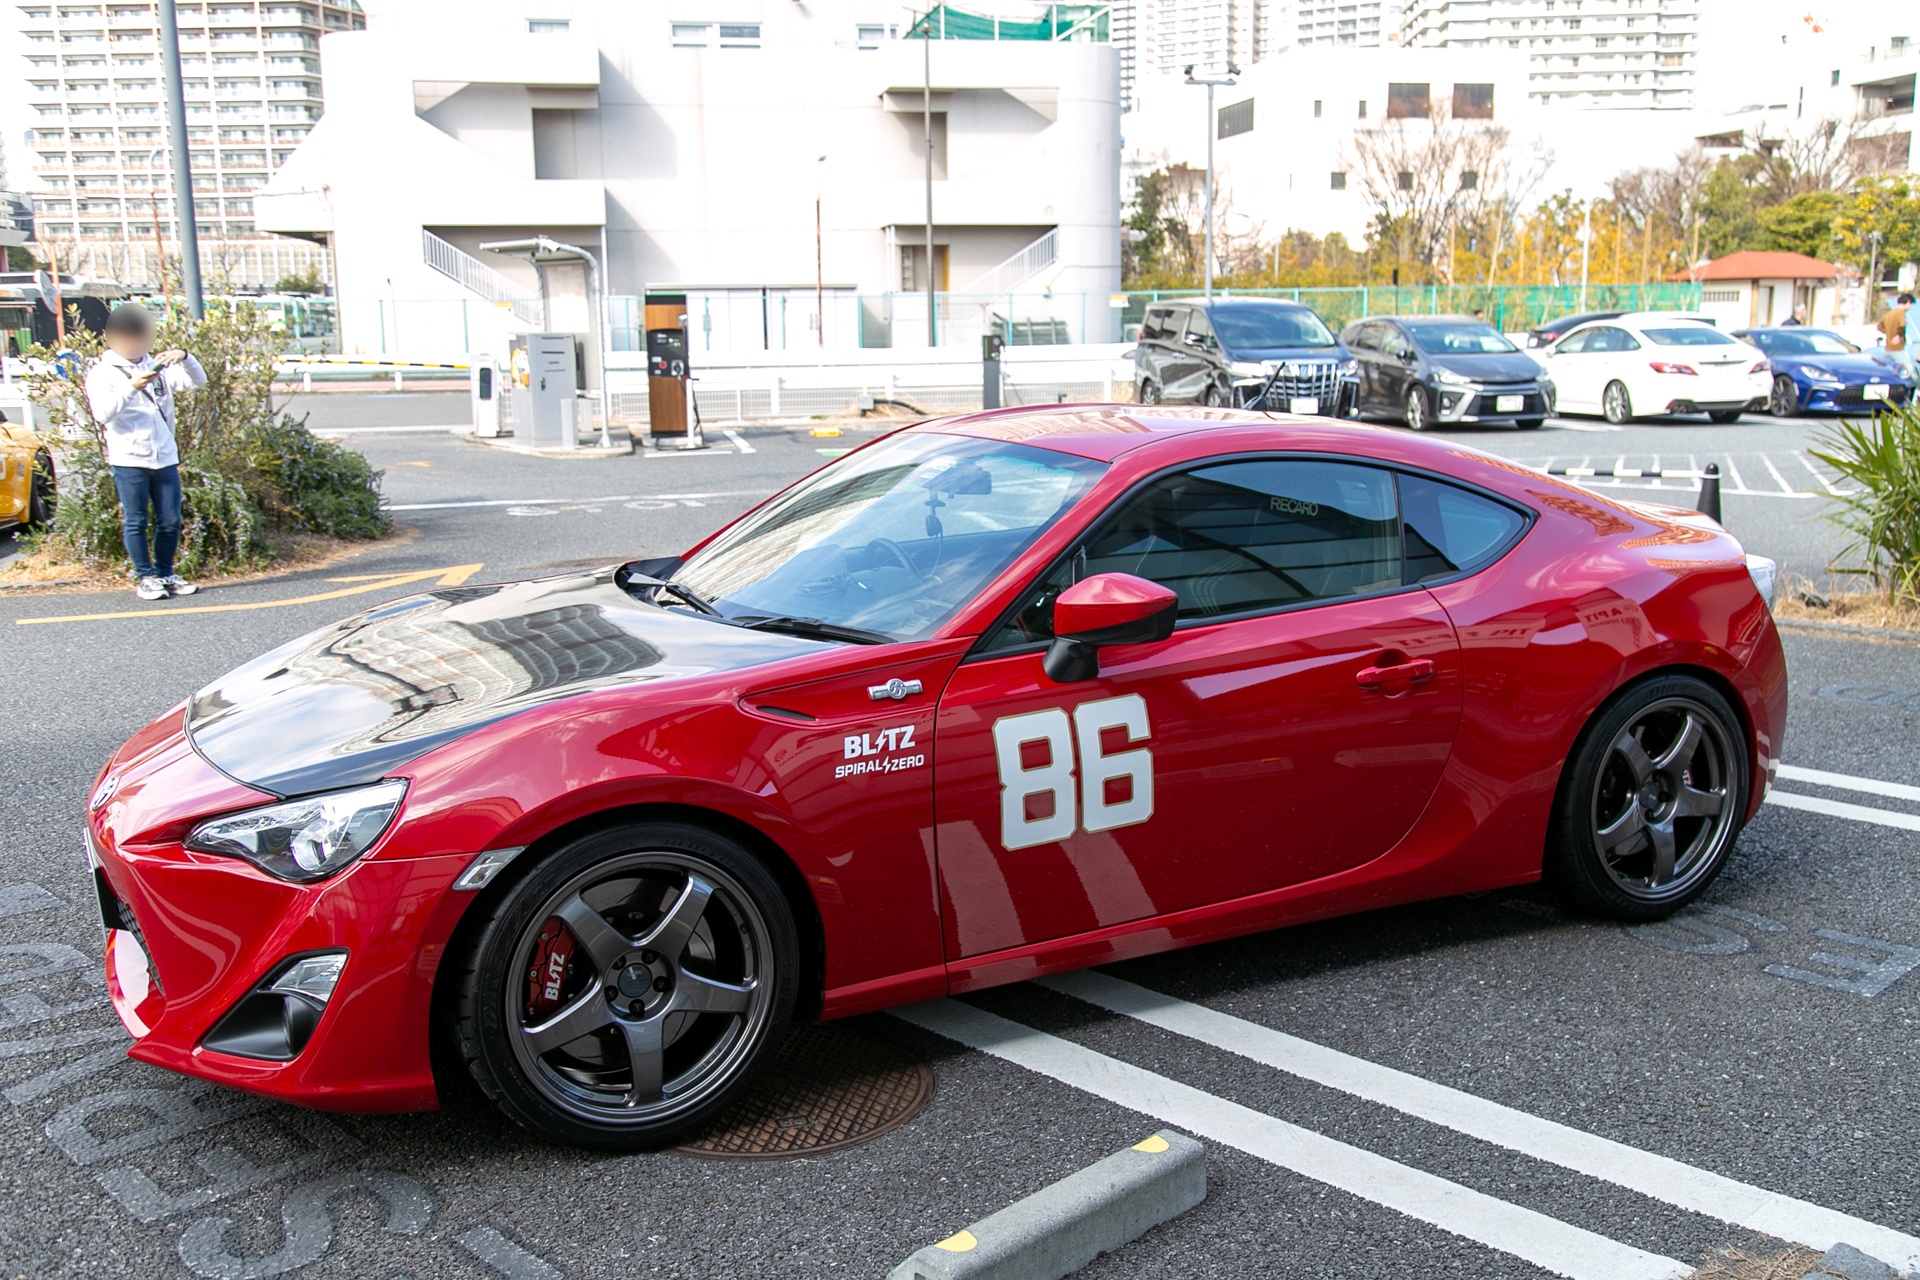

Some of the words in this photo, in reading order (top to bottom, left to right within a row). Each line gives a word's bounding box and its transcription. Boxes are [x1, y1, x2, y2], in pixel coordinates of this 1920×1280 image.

[1270, 497, 1319, 517] RECARO
[843, 725, 915, 759] BLITZ
[835, 759, 883, 779] SPIRAL
[891, 754, 925, 771] ZERO
[992, 692, 1155, 851] 86
[544, 952, 565, 1001] BLITZ
